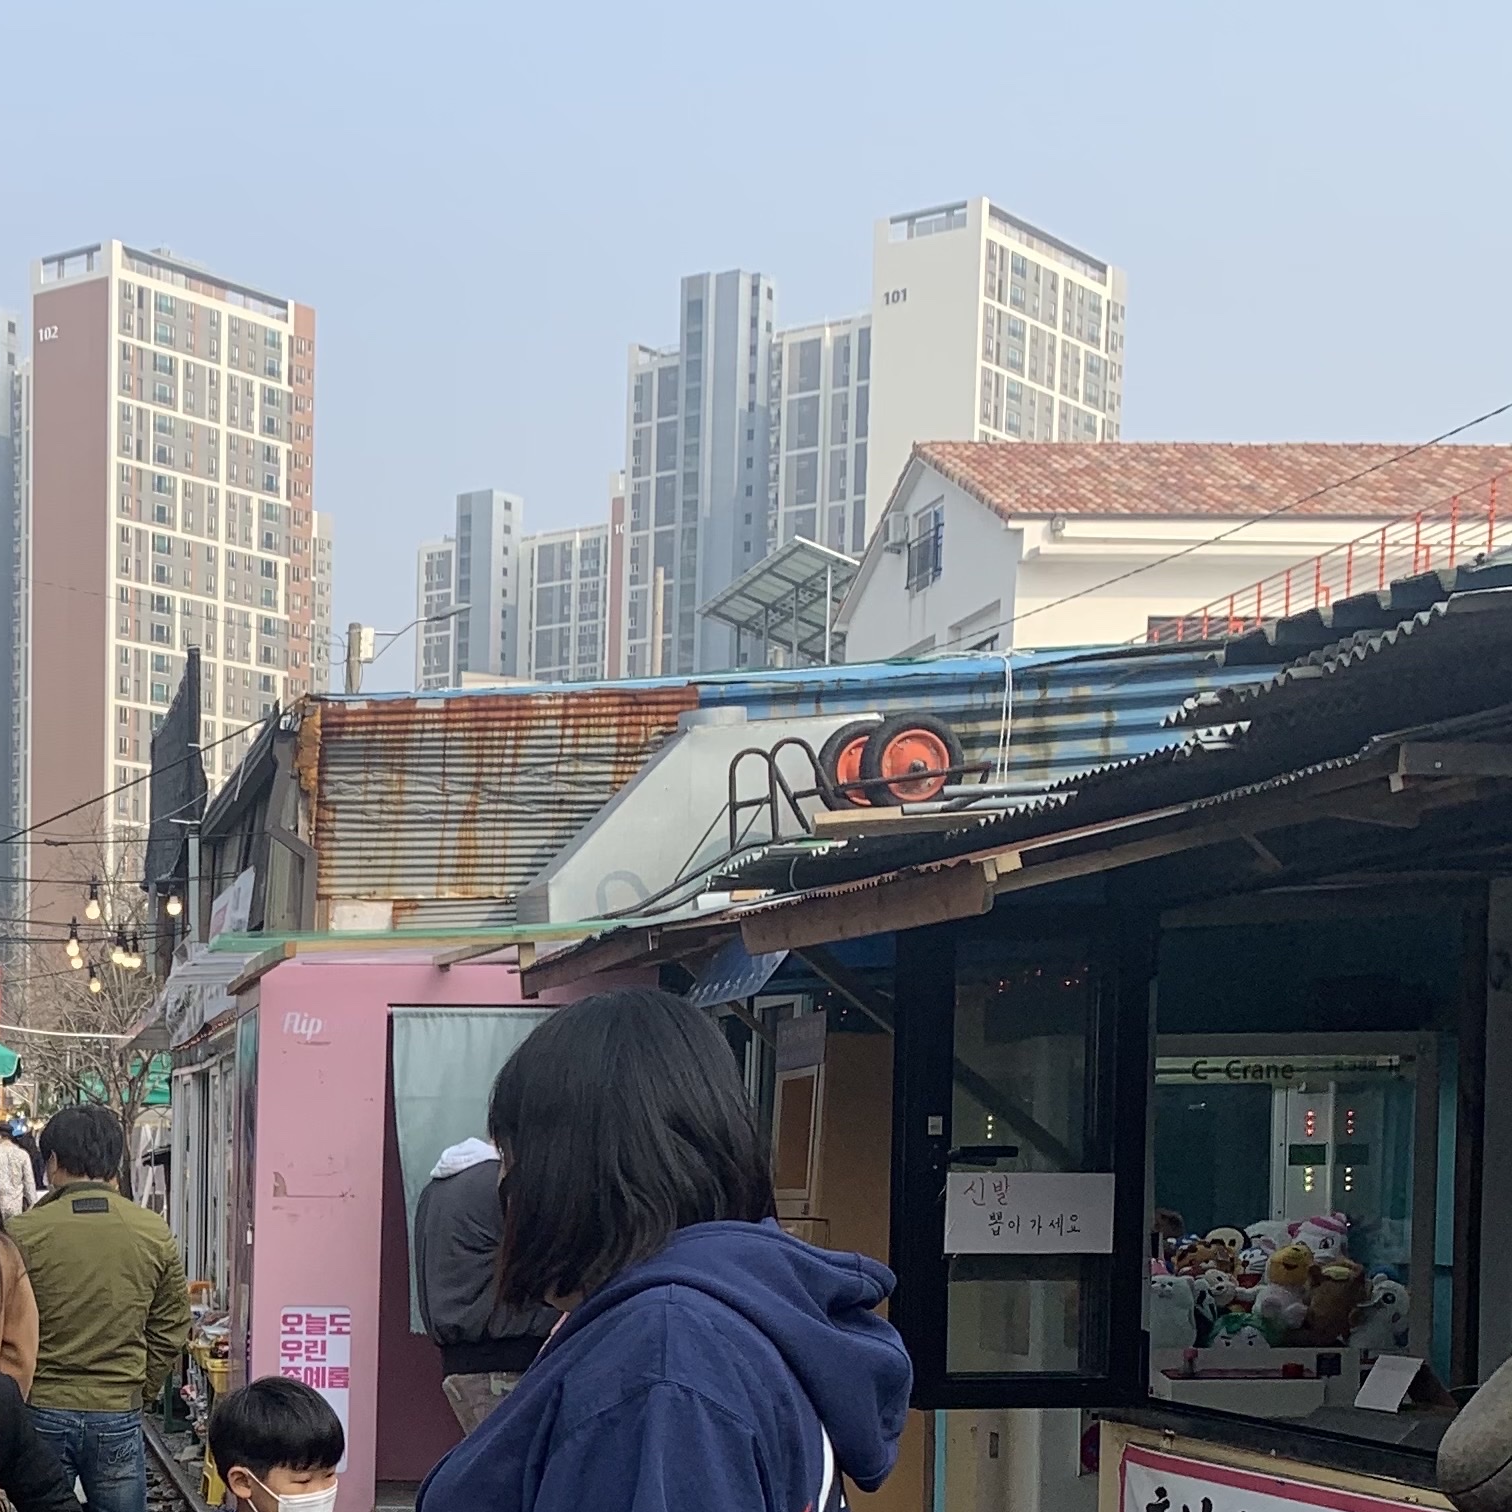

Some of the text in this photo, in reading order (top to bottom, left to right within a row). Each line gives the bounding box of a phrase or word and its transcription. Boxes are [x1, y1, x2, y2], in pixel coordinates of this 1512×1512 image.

[883, 287, 908, 305] 101
[38, 325, 59, 342] 102
[283, 1012, 322, 1040] Flip
[963, 1174, 1010, 1206] 신발
[281, 1313, 351, 1336] 오늘도
[281, 1339, 327, 1362] 우린
